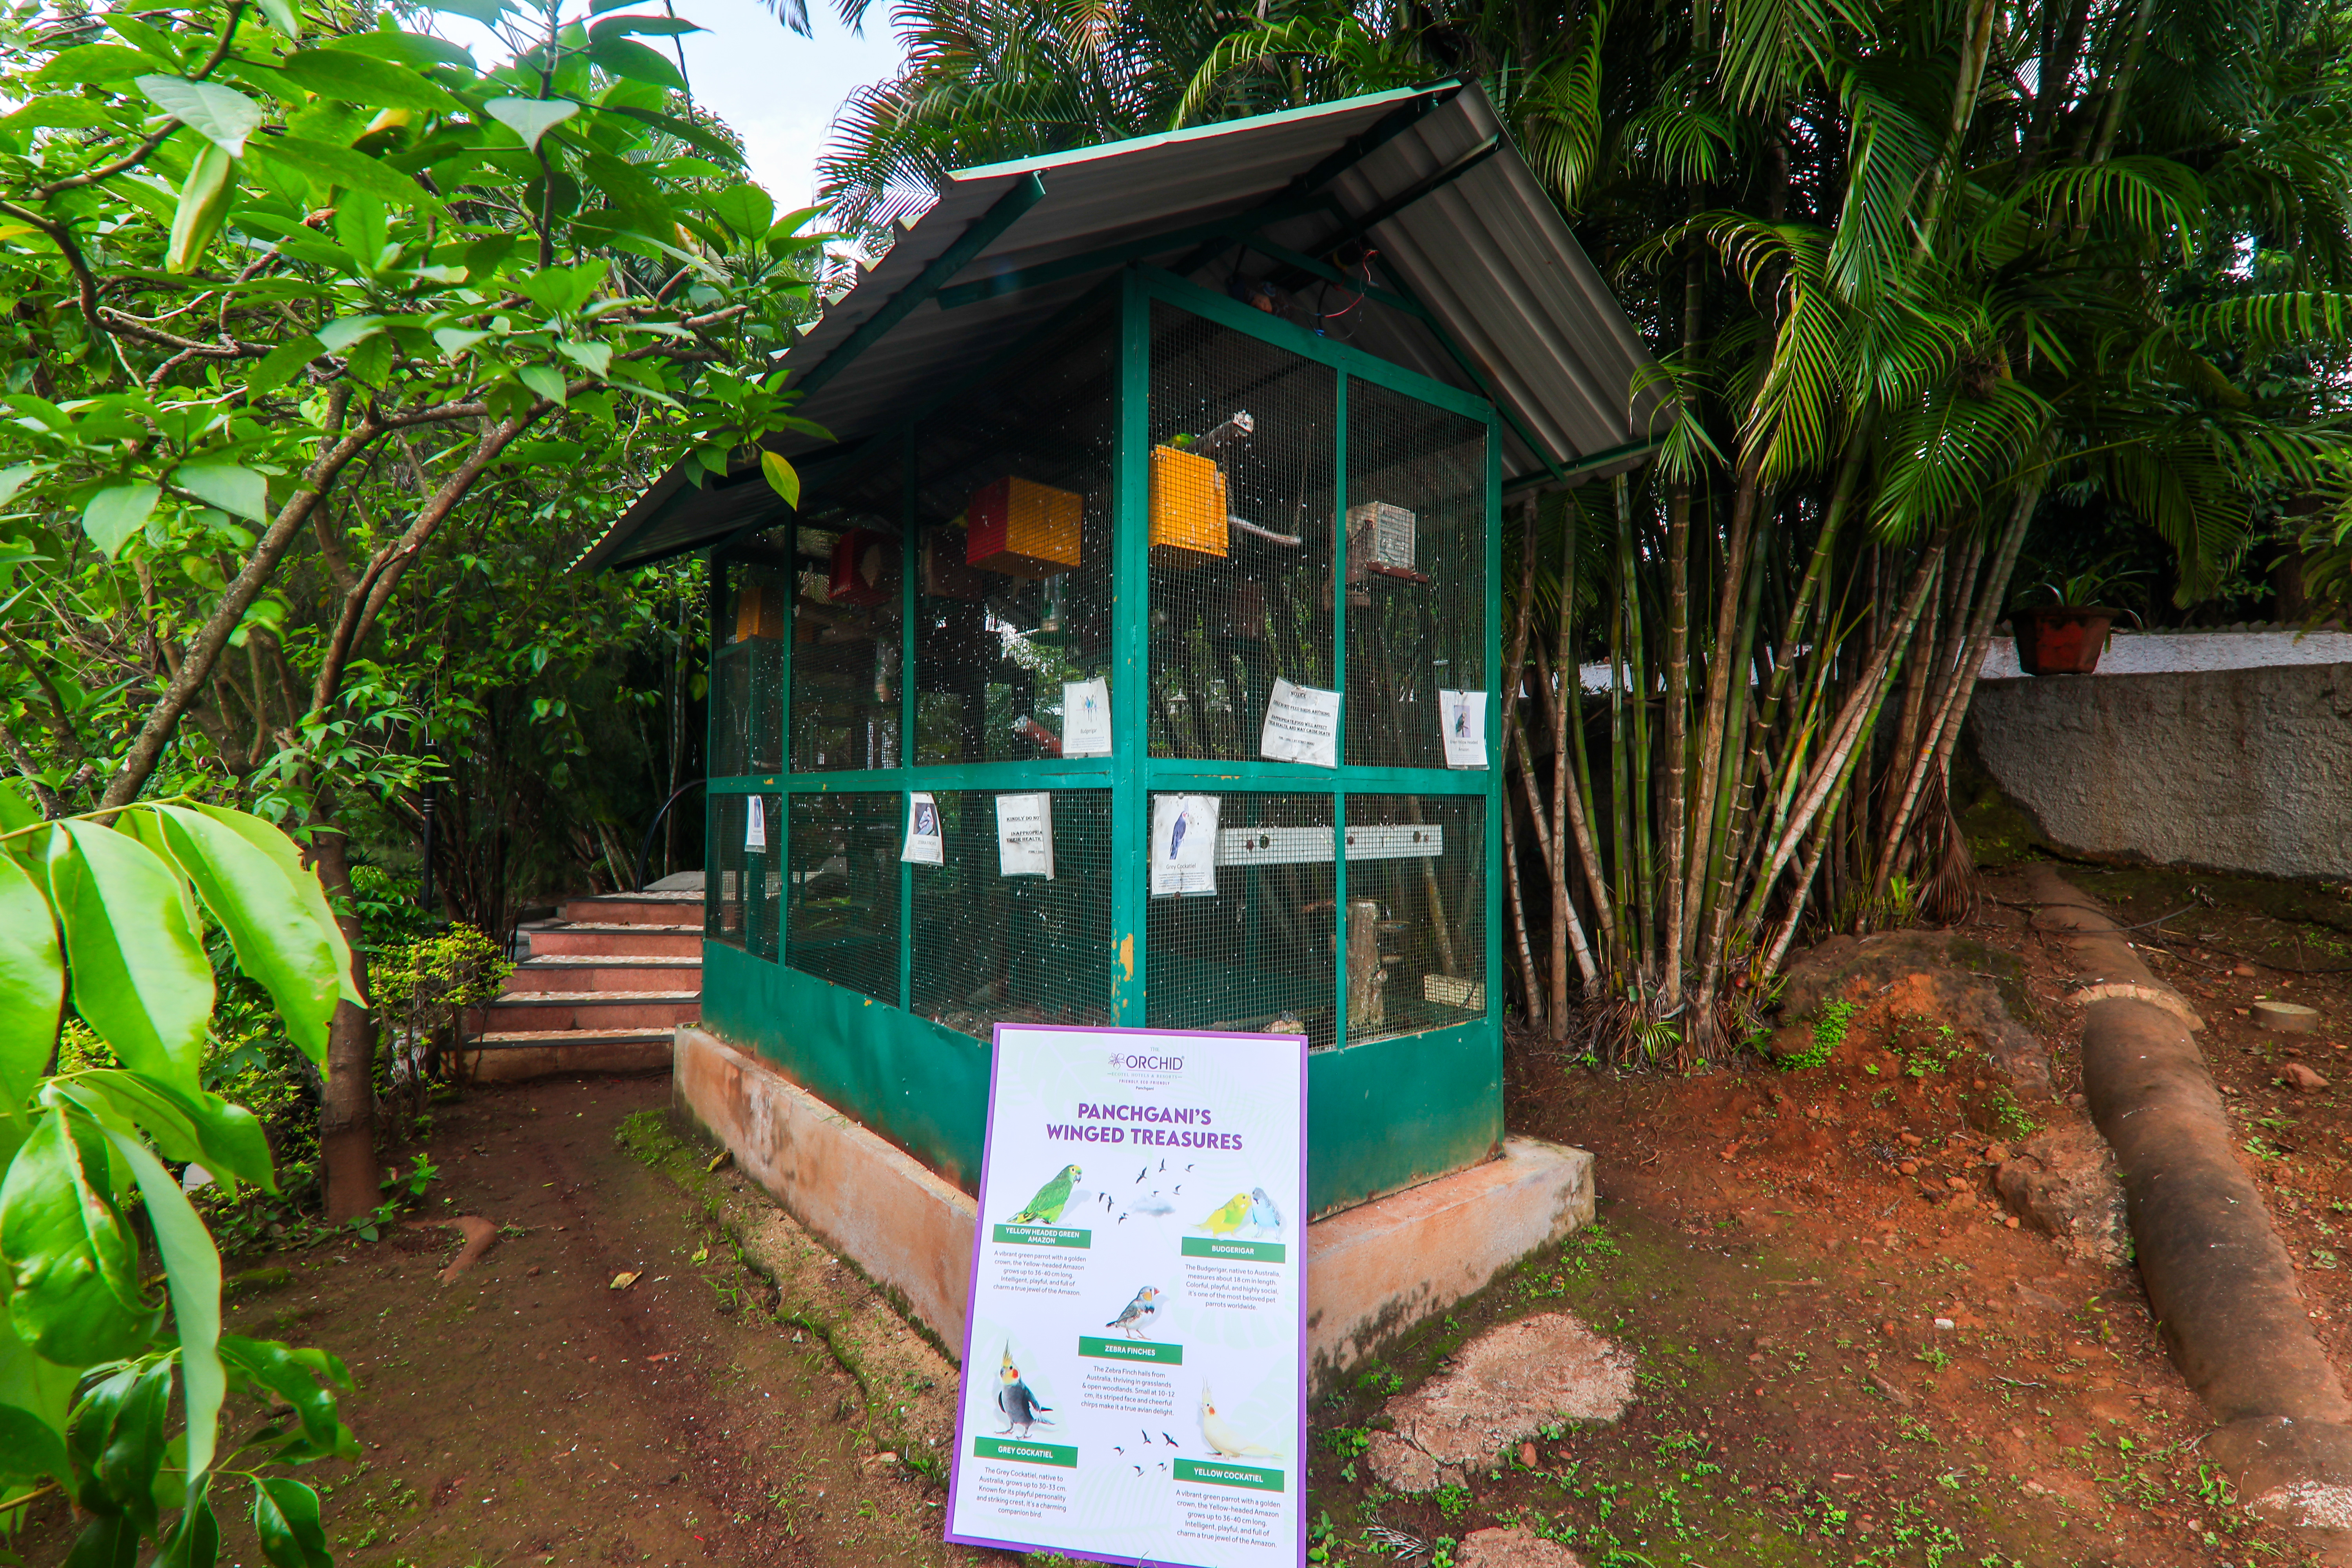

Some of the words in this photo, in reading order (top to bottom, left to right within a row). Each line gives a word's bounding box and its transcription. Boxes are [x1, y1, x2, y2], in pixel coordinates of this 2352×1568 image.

[1126, 1055, 1183, 1070] ORCHID
[1078, 1103, 1211, 1125] PANCHGANI'S
[1046, 1124, 1124, 1143] WINGED
[1131, 1128, 1242, 1150] TREASURES
[1027, 1236, 1055, 1244] AMAZON
[1212, 1245, 1254, 1254] BUDGERIGAR
[1023, 1260, 1062, 1269] Yellow-headed
[1197, 1265, 1227, 1273] Budgerigar,
[1243, 1286, 1259, 1294] highly
[1105, 1345, 1126, 1353] ZEBRA
[1127, 1347, 1155, 1356] FINCHES
[1086, 1374, 1112, 1382] Australia,
[1113, 1376, 1134, 1385] thriving
[1153, 1408, 1174, 1416] delight.
[998, 1446, 1015, 1454] GREY
[1016, 1448, 1053, 1458] COCKATIEL
[996, 1468, 1009, 1477] Grey
[1010, 1470, 1037, 1479] Cockatiel,
[1194, 1468, 1223, 1477] YELLOW
[1224, 1471, 1263, 1483] COCKATIEL
[979, 1475, 1004, 1485] Australia,
[1015, 1490, 1034, 1498] playful
[1034, 1493, 1065, 1503] personality
[988, 1496, 1008, 1505] striking
[1040, 1502, 1066, 1512] charming
[998, 1508, 1029, 1516] companion
